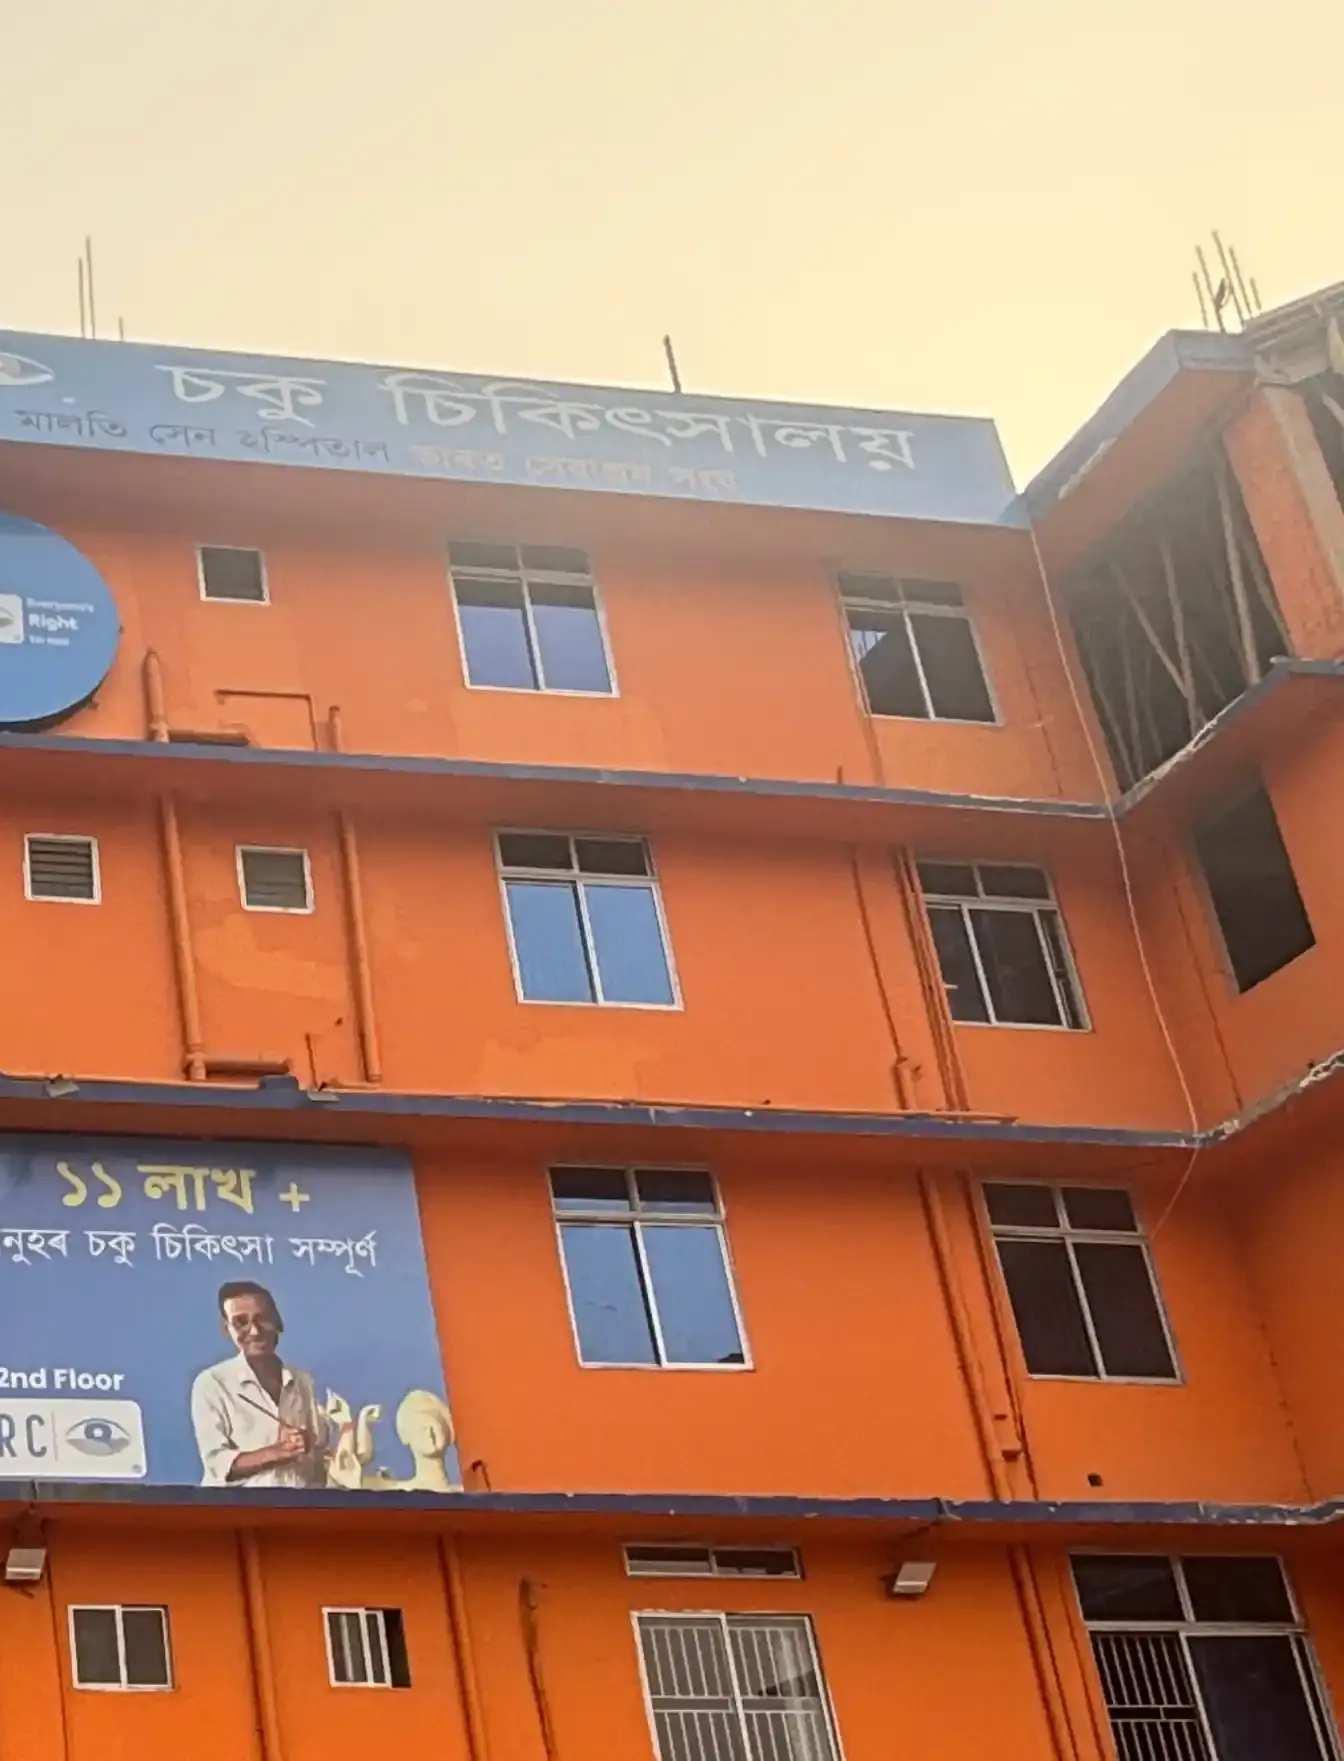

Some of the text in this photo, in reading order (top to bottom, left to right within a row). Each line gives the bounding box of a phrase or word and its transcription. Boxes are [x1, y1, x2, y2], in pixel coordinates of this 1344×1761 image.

[154, 363, 326, 427] চকু
[28, 612, 79, 632] Right
[56, 1160, 123, 1208] ১১
[137, 1163, 257, 1215] লাখ
[83, 1230, 137, 1268] চকু
[149, 1222, 274, 1266] চিকিৎসা
[53, 1368, 125, 1391] Floor
